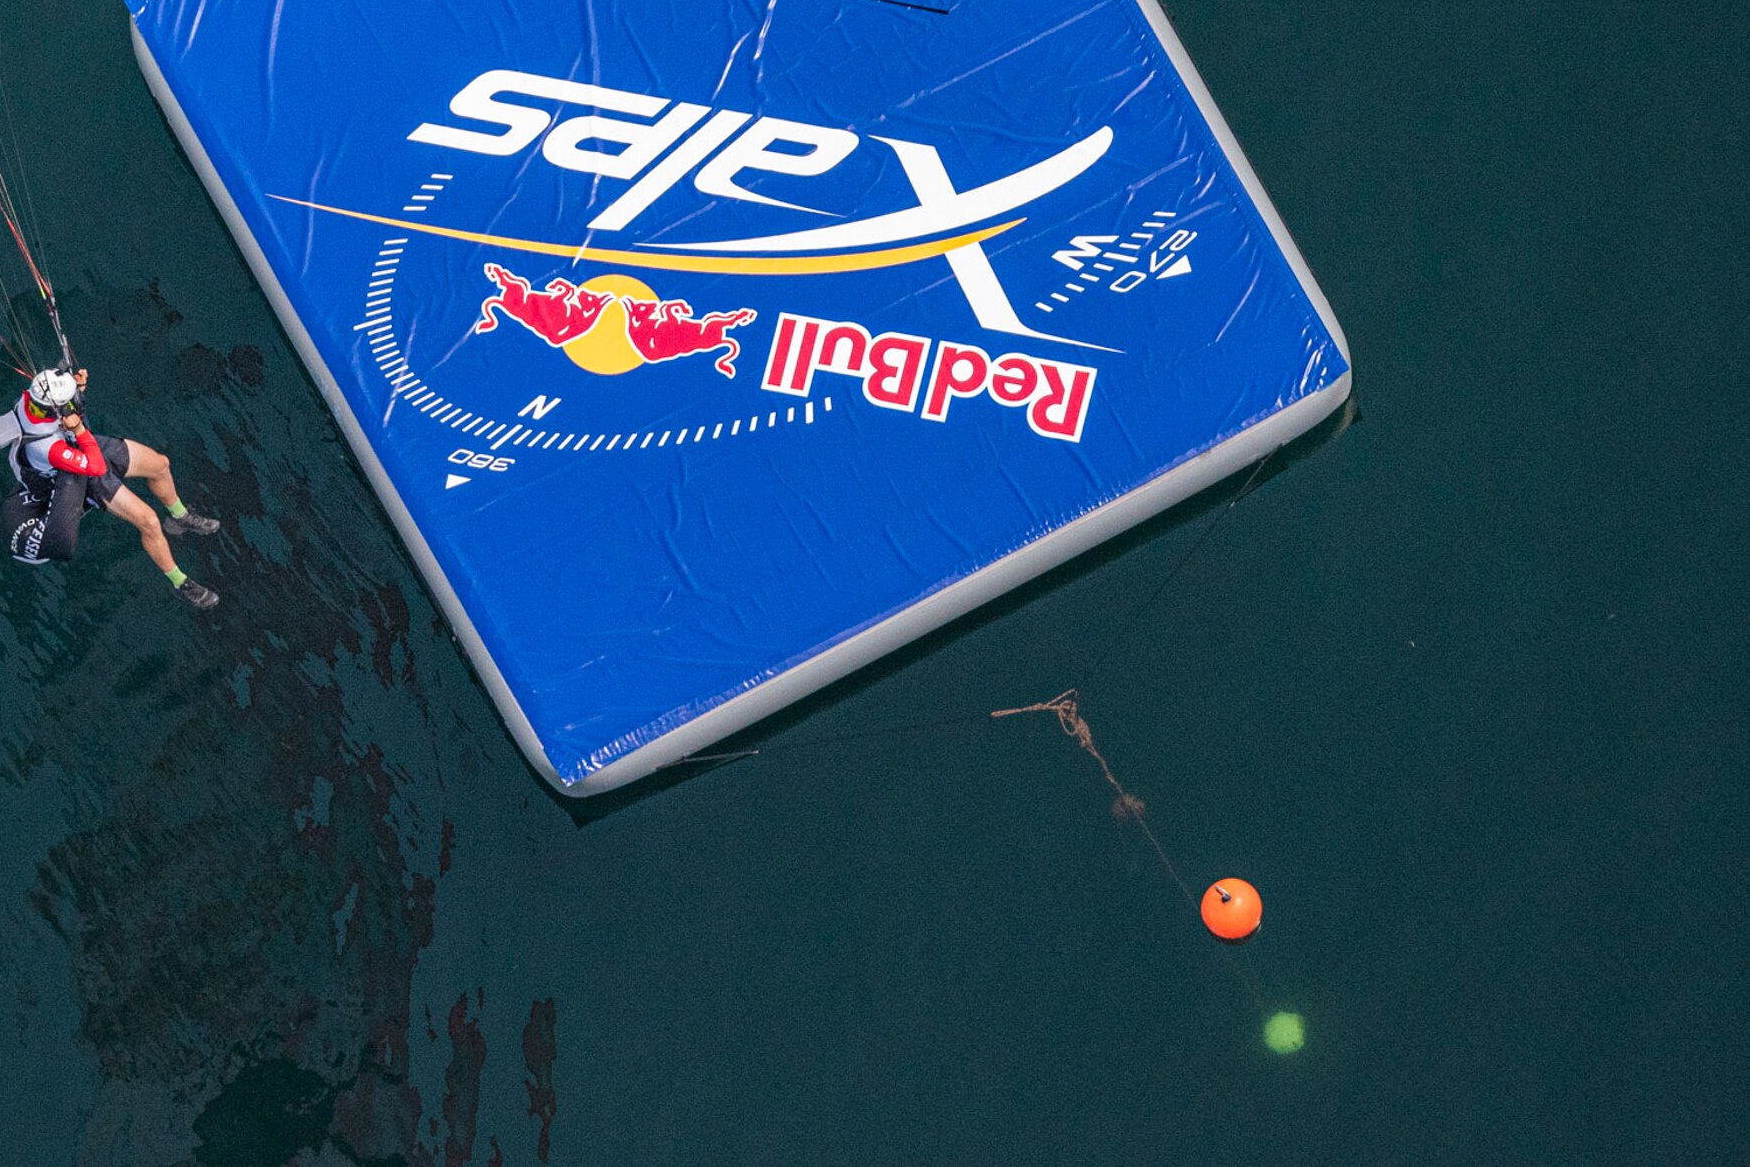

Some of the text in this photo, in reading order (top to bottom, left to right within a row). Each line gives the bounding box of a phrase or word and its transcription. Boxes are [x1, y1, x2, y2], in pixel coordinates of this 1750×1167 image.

[1109, 230, 1198, 292] 270
[517, 395, 562, 420] N
[448, 449, 516, 472] 360
[11, 518, 39, 554] DVANCE
